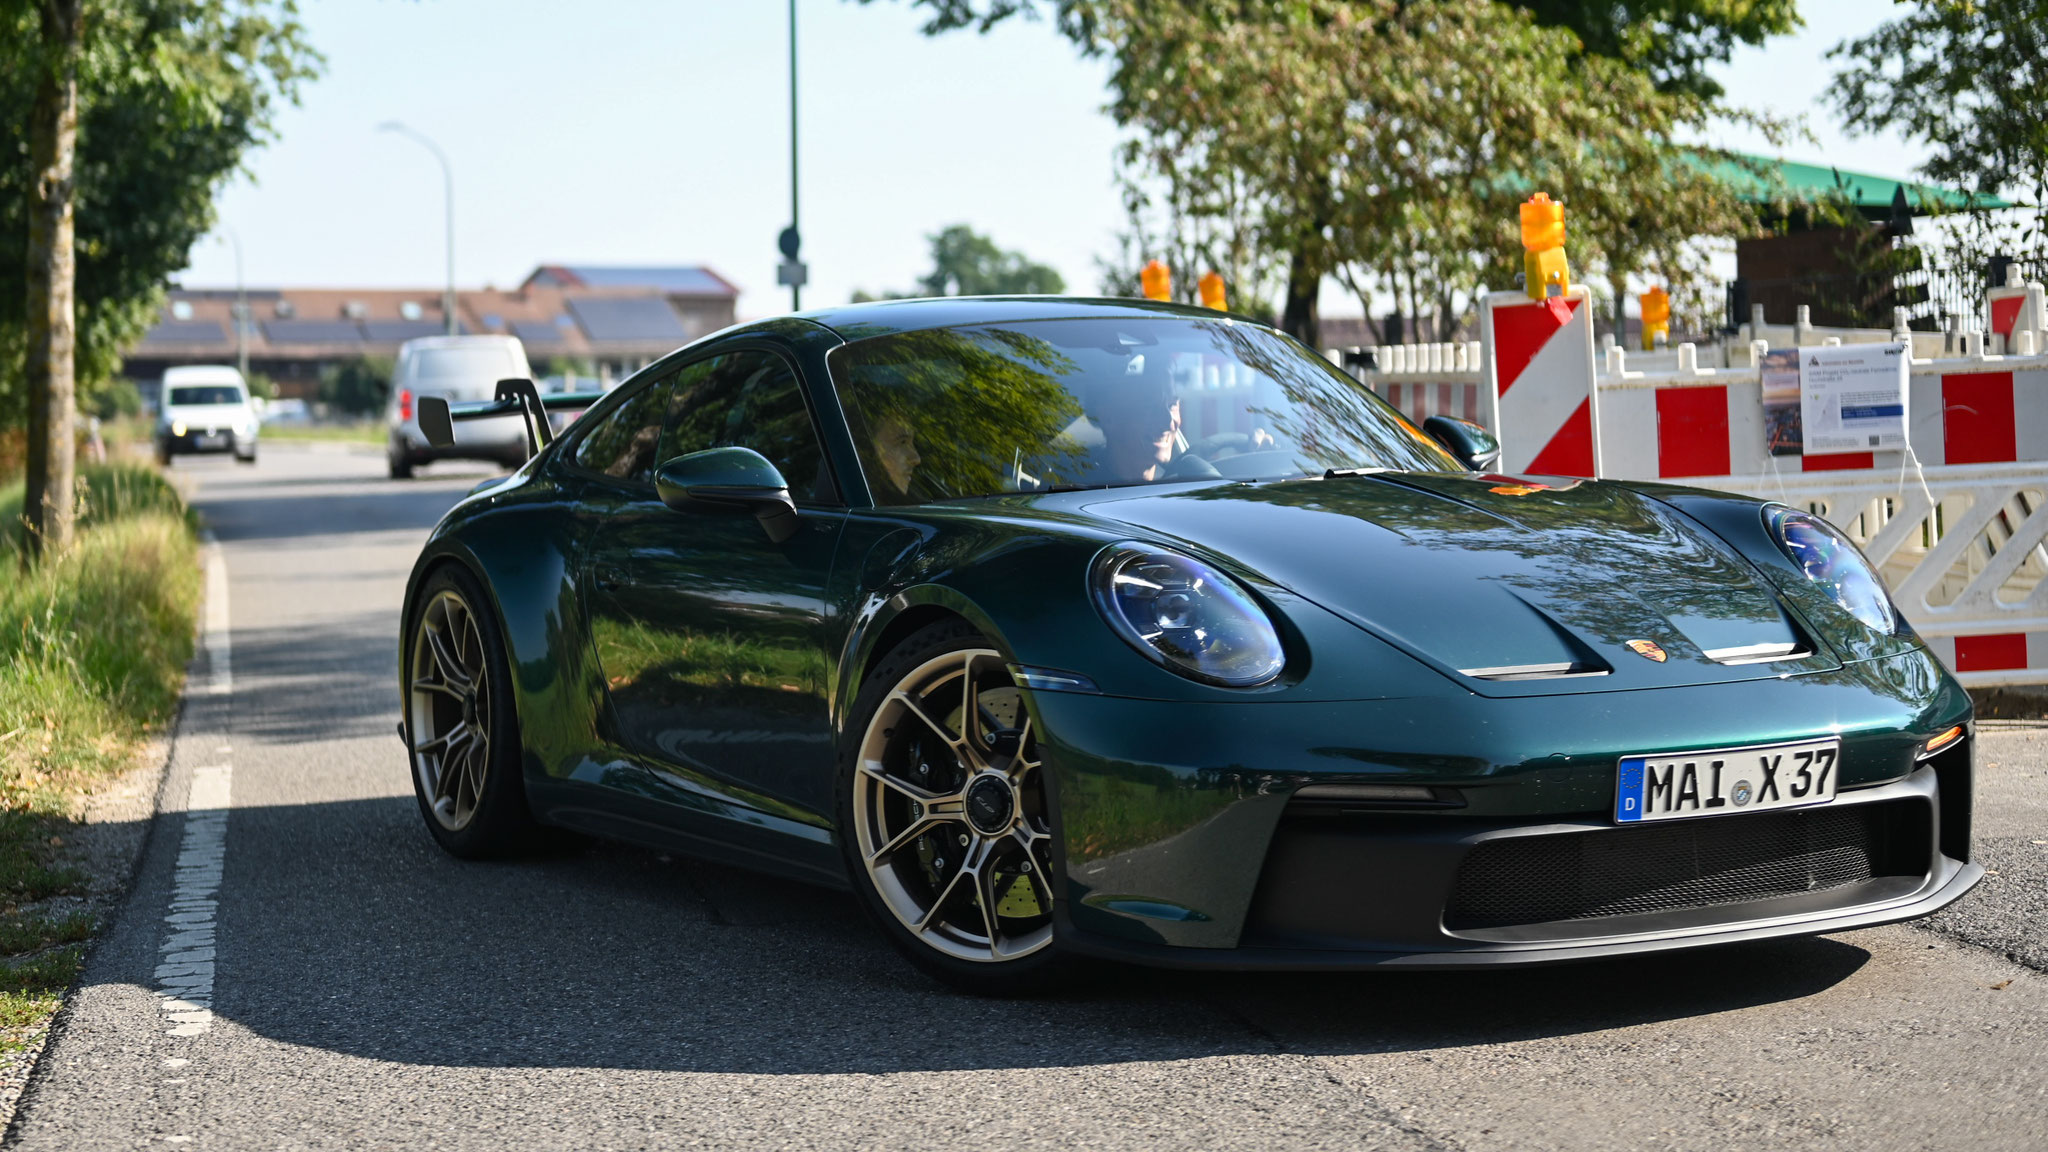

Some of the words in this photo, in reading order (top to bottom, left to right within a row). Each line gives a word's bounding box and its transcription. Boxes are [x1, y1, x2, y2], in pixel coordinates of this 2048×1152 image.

[1646, 760, 1725, 813] MAI
[1756, 754, 1782, 804] X
[1790, 748, 1837, 799] 37
[1624, 797, 1636, 811] D
